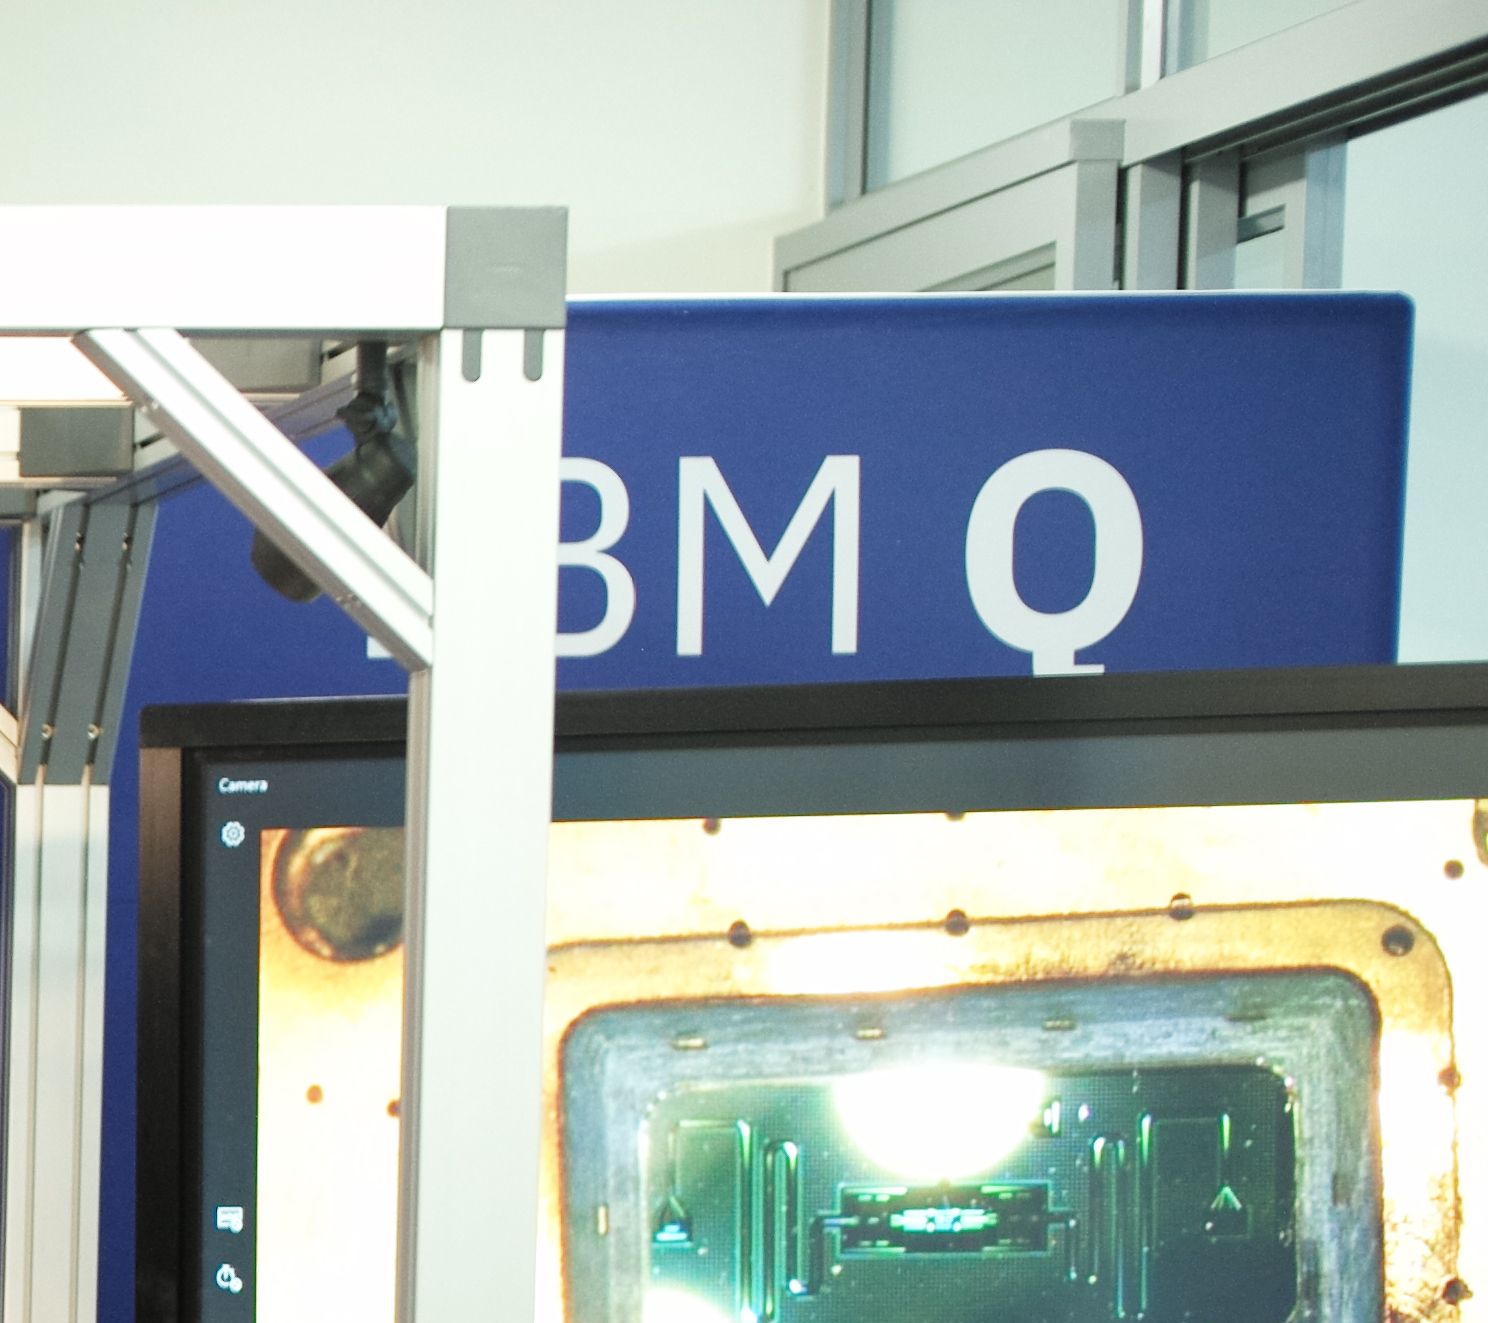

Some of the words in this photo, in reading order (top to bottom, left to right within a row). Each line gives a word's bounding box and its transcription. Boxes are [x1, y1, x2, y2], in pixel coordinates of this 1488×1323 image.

[367, 453, 861, 659] BM
[965, 448, 1143, 678] Q
[218, 777, 268, 794] Camera
